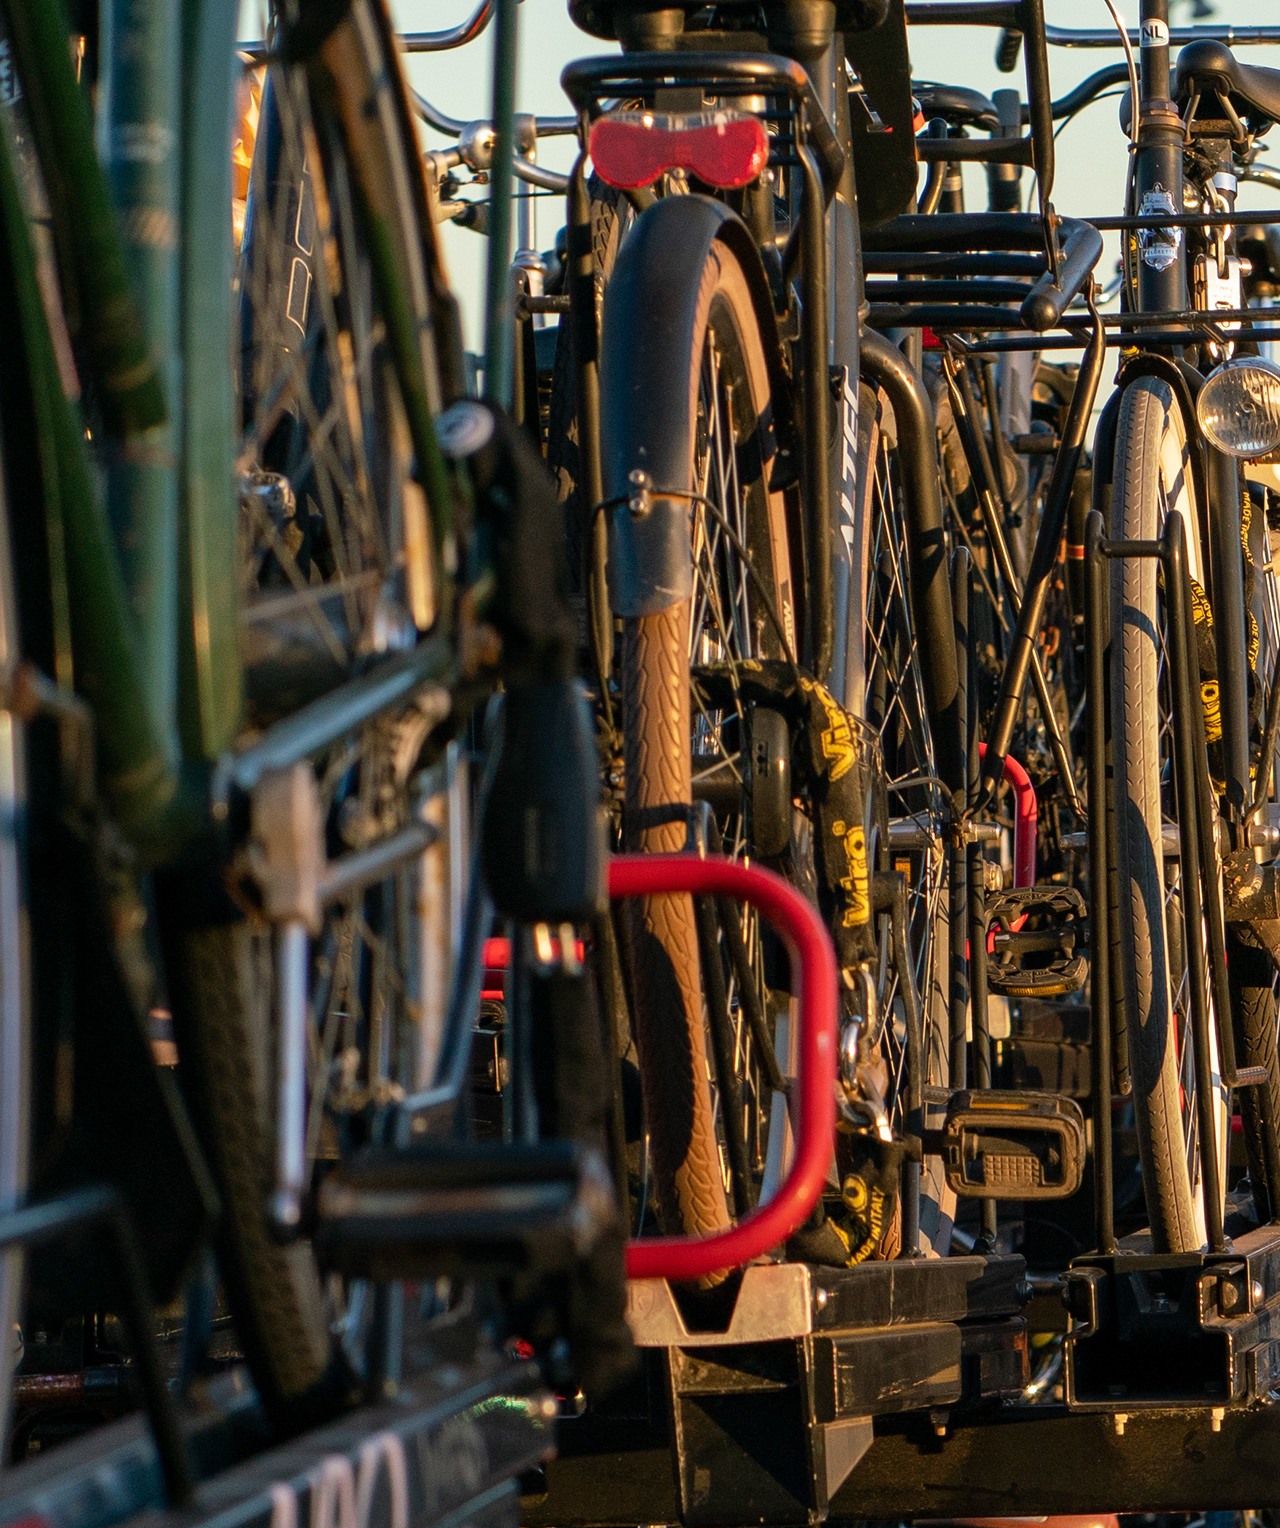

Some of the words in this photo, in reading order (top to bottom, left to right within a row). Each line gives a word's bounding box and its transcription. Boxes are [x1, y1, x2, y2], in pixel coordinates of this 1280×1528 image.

[1142, 25, 1164, 39] NL
[841, 364, 859, 567] ALTEC
[1242, 491, 1251, 522] MADE
[1192, 585, 1206, 598] IN
[1199, 598, 1214, 628] MADE
[870, 1185, 885, 1225] ITALY
[871, 1225, 881, 1241] IN
[845, 1237, 875, 1269] MADE
